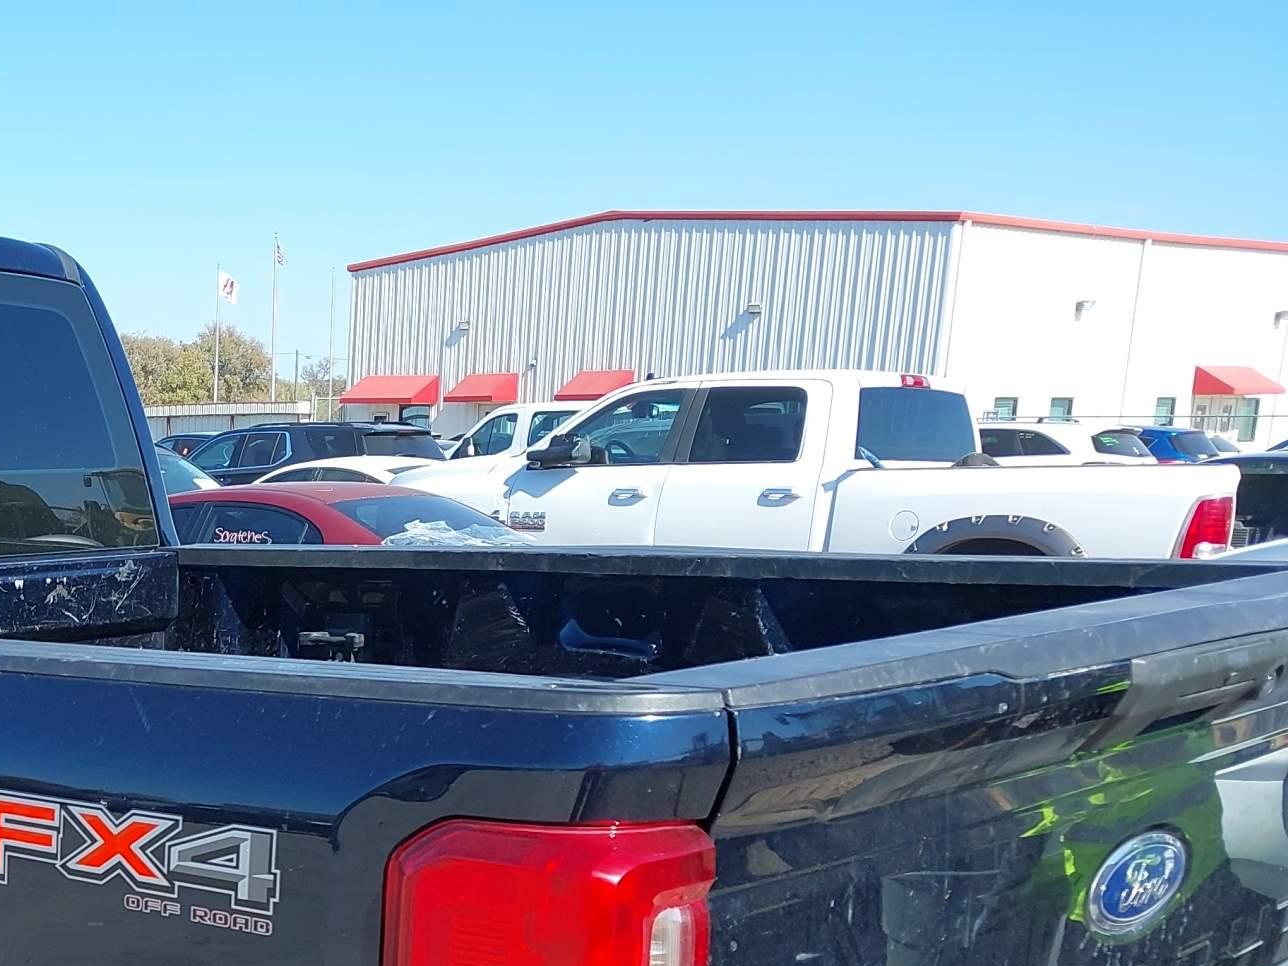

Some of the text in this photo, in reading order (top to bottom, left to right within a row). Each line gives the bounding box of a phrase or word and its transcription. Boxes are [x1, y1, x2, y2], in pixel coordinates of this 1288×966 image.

[1117, 848, 1176, 914] Ford
[123, 894, 273, 937] OFF ROAD
